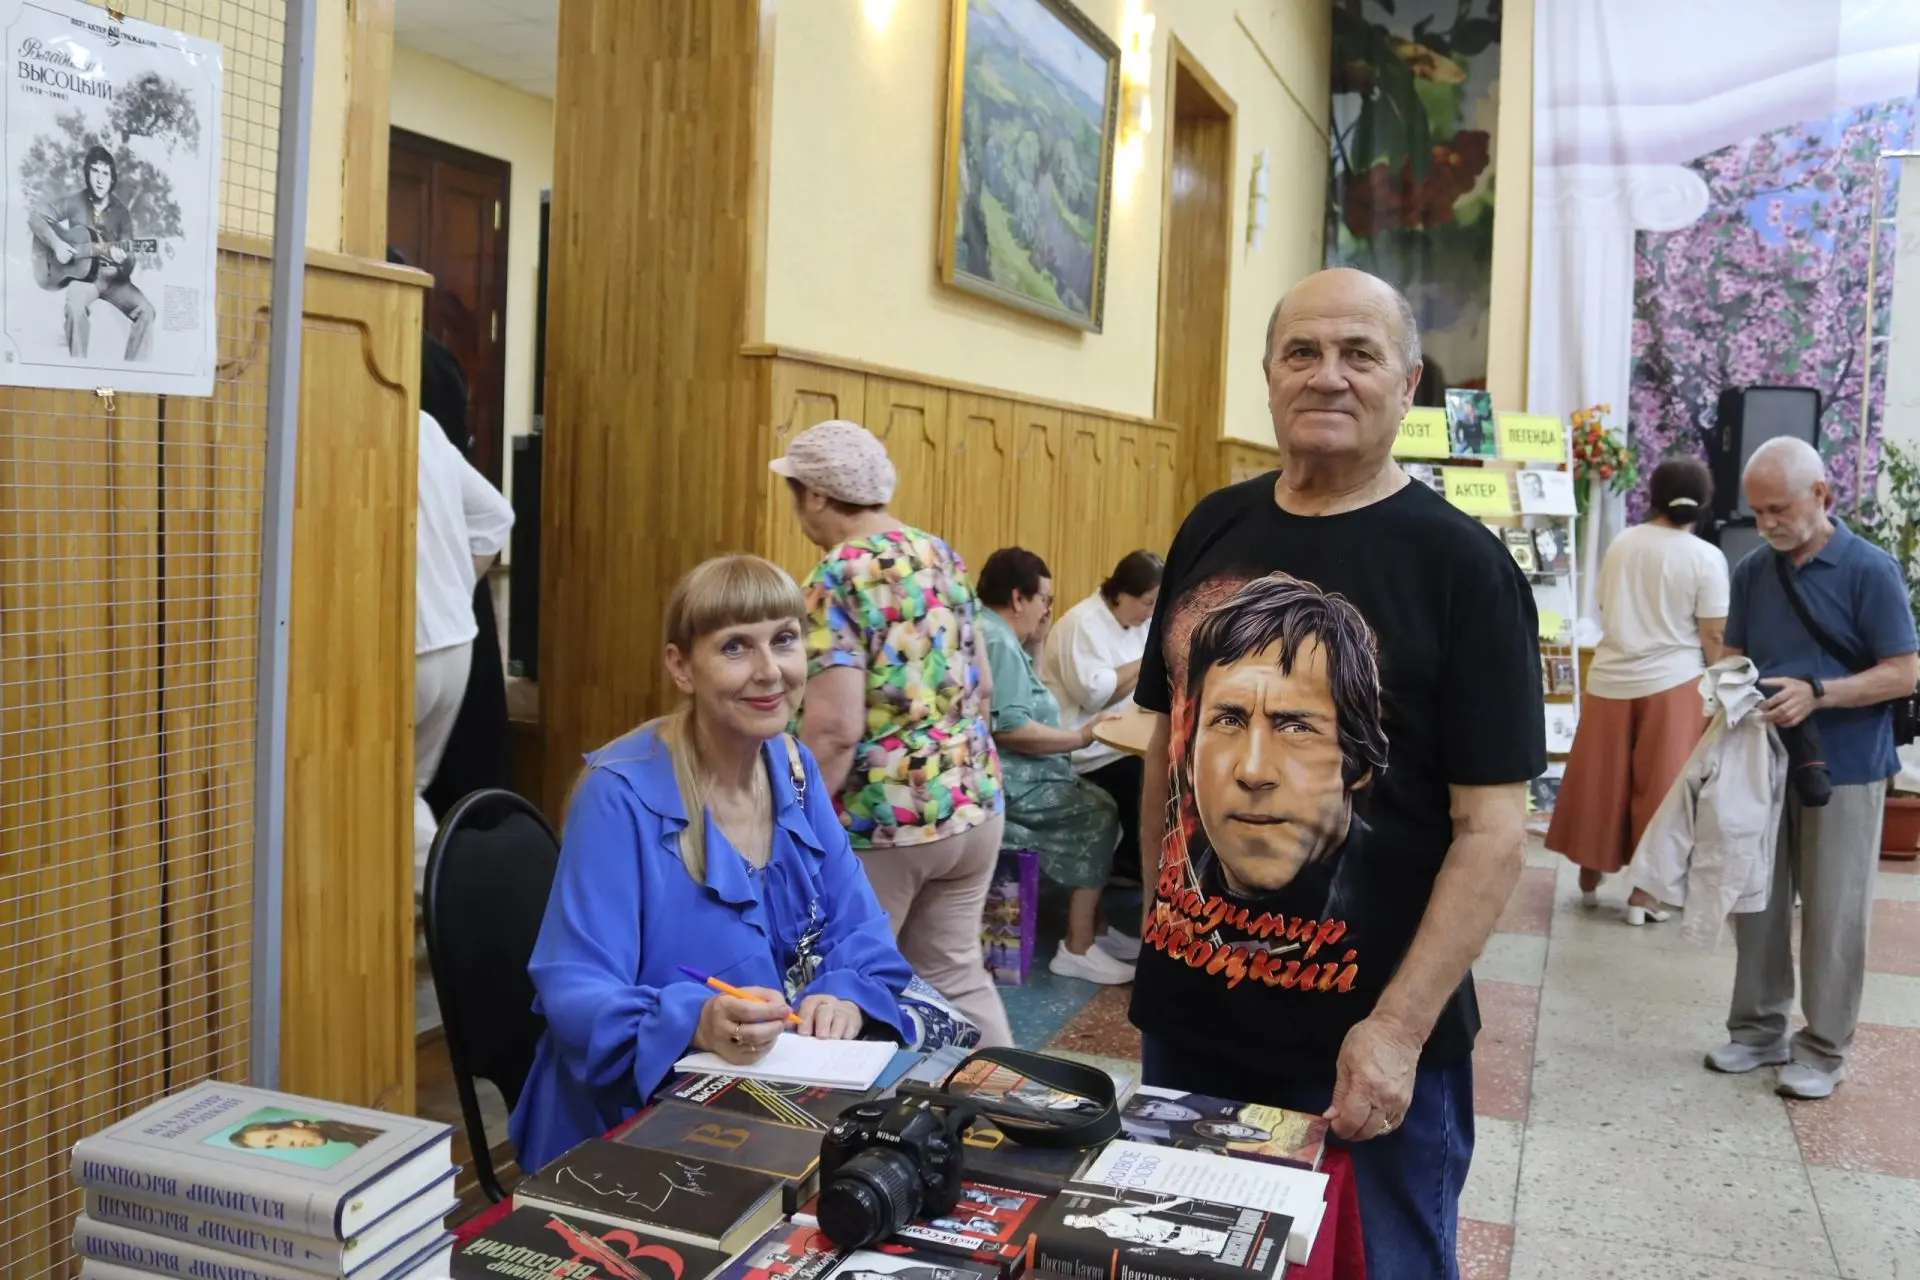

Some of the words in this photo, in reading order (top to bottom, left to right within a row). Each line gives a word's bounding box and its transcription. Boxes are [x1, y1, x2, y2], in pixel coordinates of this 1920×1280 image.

[18, 61, 112, 100] ВЫСОЦКИЙ
[876, 1131, 901, 1143] Nikon
[83, 1161, 177, 1197] ВЫСОЦКИЙ
[99, 1195, 188, 1233] ВЫСОЦКИЙ
[186, 1184, 285, 1221] ВЛАДИМИР
[86, 1235, 179, 1272] ВЫСОЦКИЙ
[198, 1220, 293, 1259] ВЛАДИМИР
[462, 1238, 598, 1280] ВЫСОЦКИЙ
